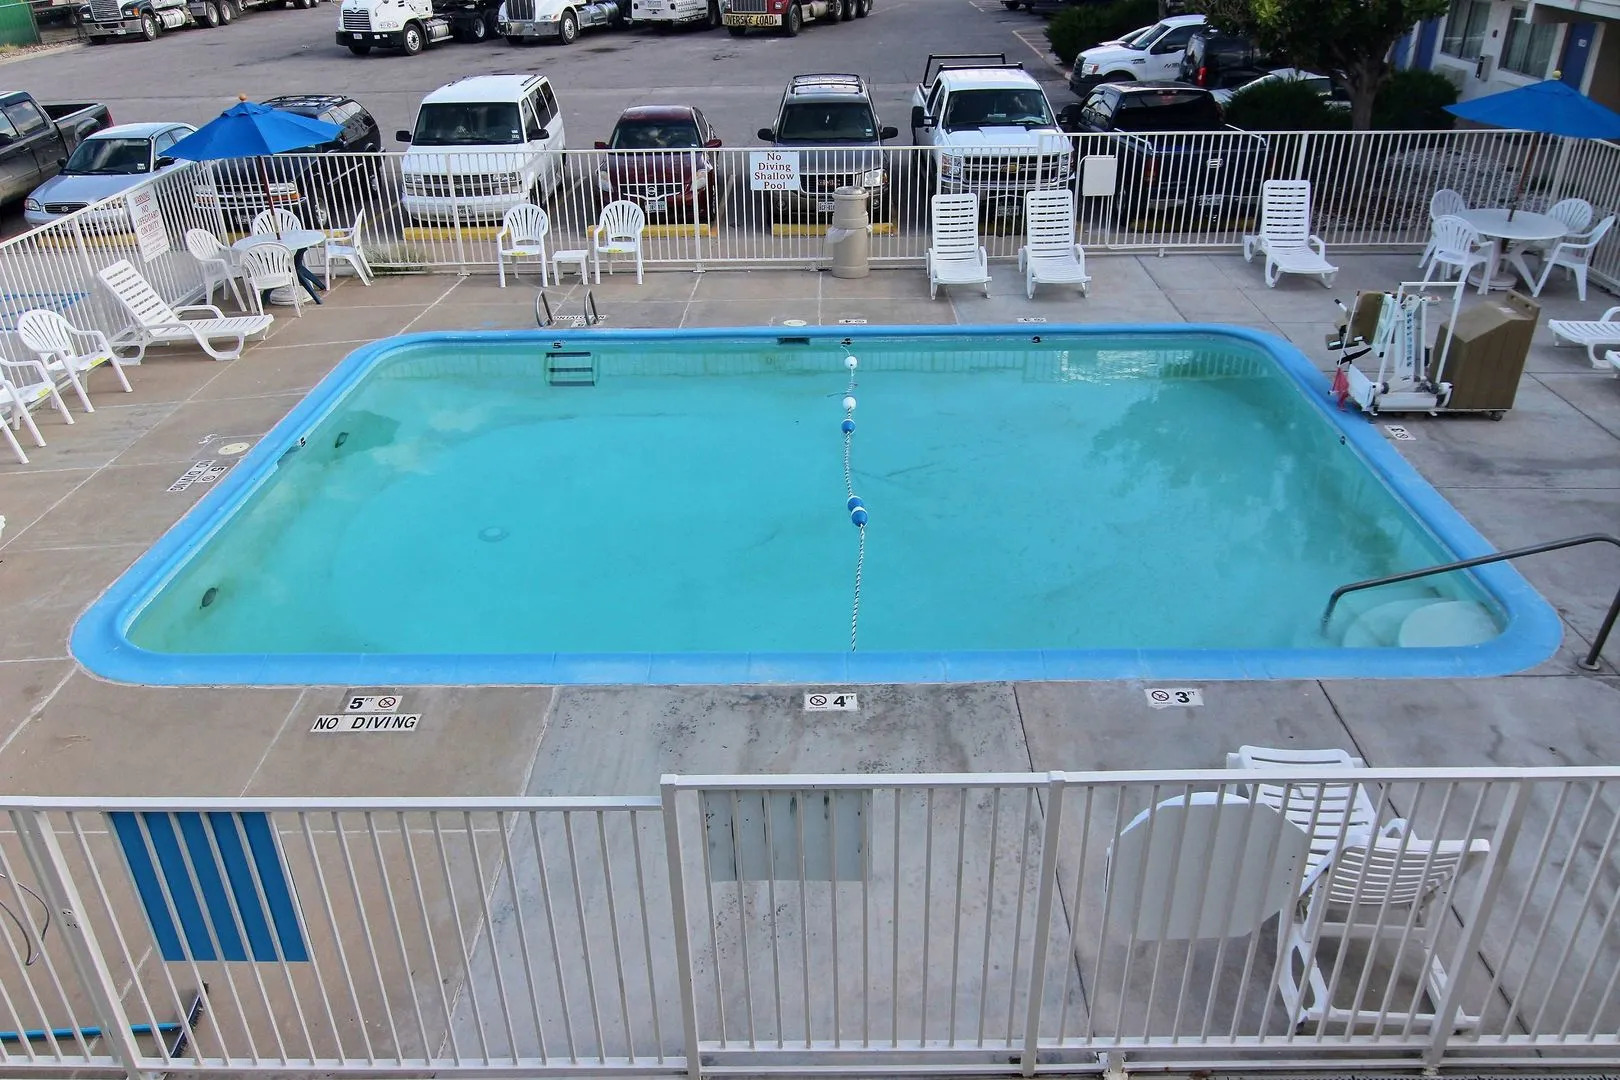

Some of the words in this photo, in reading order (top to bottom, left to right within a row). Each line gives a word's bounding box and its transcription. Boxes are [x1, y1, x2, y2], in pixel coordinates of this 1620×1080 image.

[756, 15, 774, 25] LOAD
[767, 152, 782, 161] No
[758, 162, 791, 172] Diving
[754, 171, 795, 180] Shallow
[764, 181, 786, 190] Pool
[141, 205, 149, 214] NO
[552, 341, 562, 349] 5
[833, 695, 847, 707] 4
[1175, 691, 1190, 703] 3
[349, 698, 365, 709] 5
[313, 717, 339, 730] NO
[350, 716, 417, 729] DIVING
